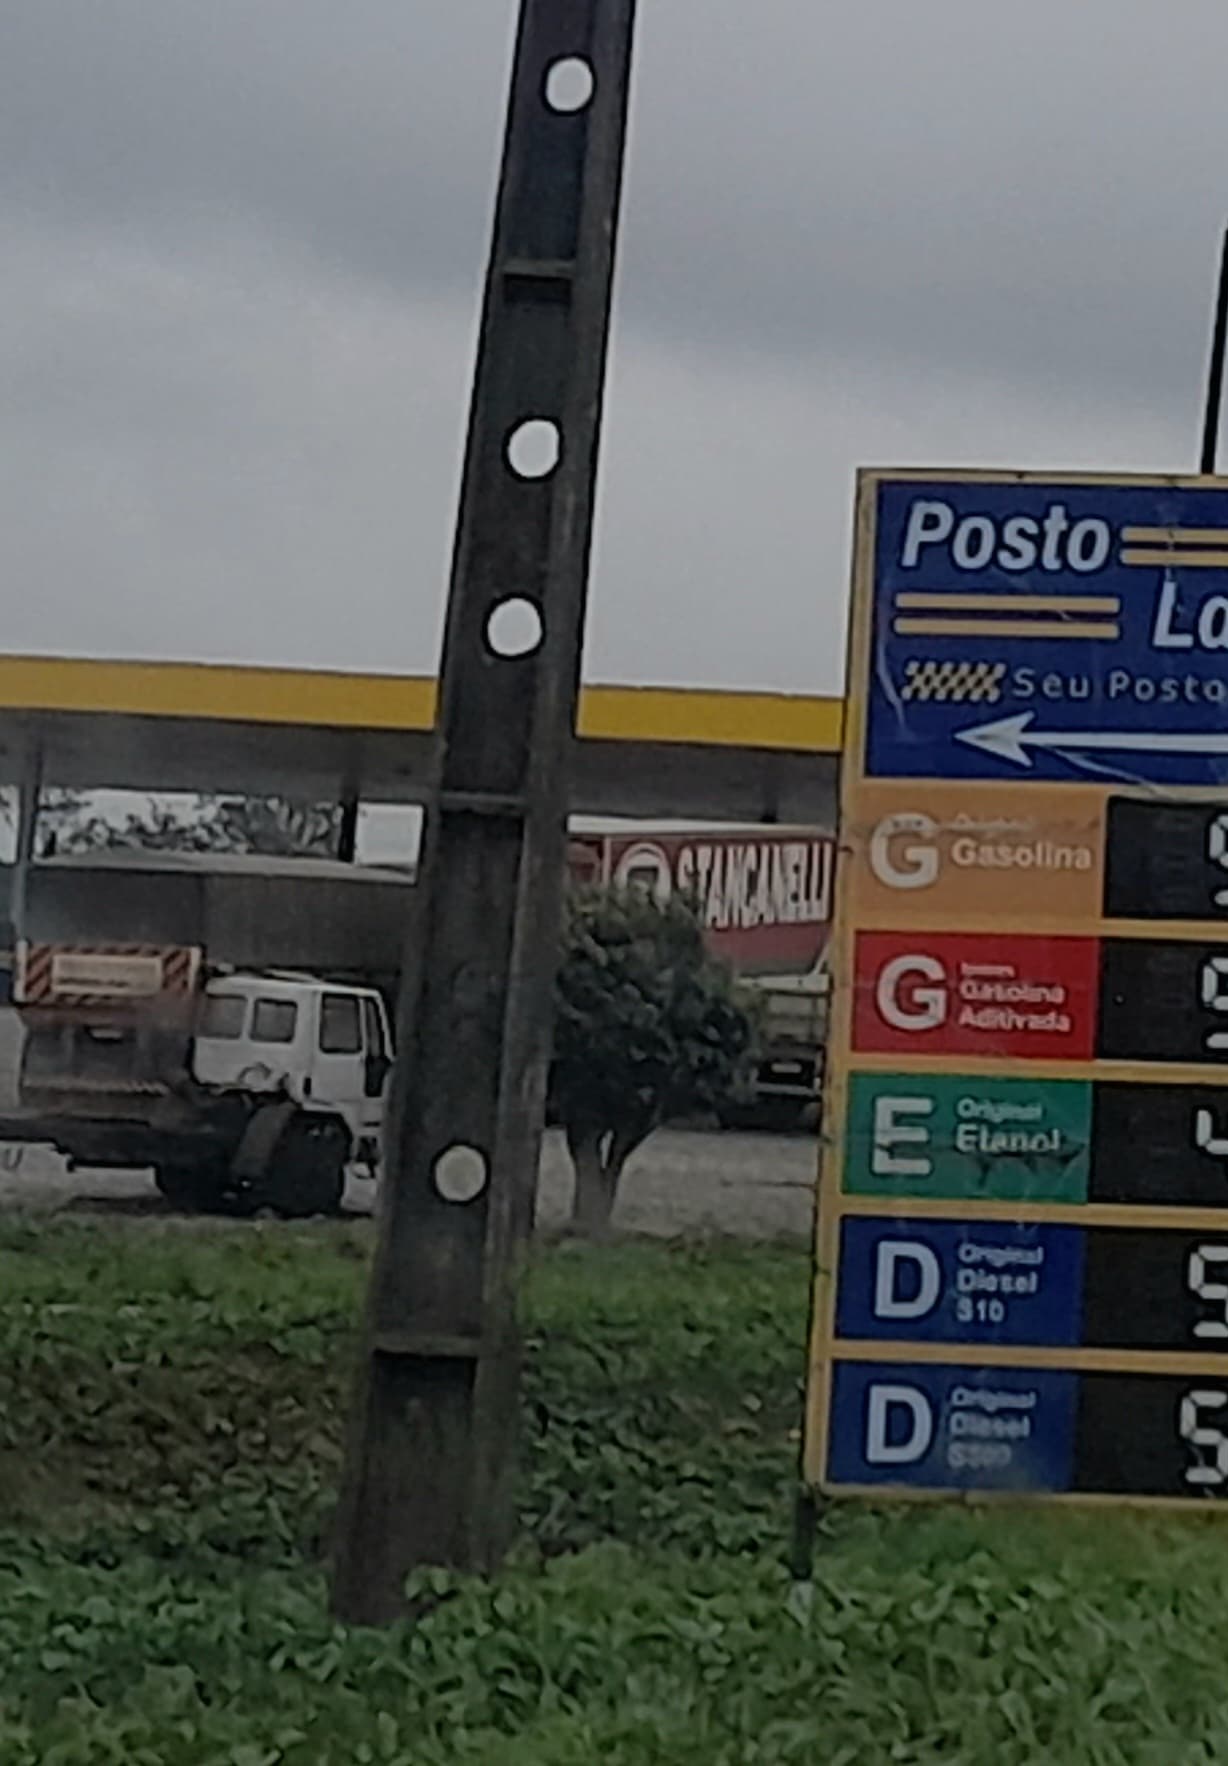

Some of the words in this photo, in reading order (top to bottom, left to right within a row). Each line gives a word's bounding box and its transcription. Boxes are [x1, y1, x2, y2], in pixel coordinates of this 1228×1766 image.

[902, 501, 1112, 569] Posto
[1013, 667, 1090, 698] Seu
[1109, 670, 1228, 703] Posto
[871, 813, 940, 889] G
[951, 837, 1092, 870] Gasolina
[876, 954, 947, 1031] G
[872, 1096, 934, 1176] E
[956, 1122, 1061, 1154] Etanol
[874, 1240, 941, 1319] D
[866, 1384, 933, 1463] D
